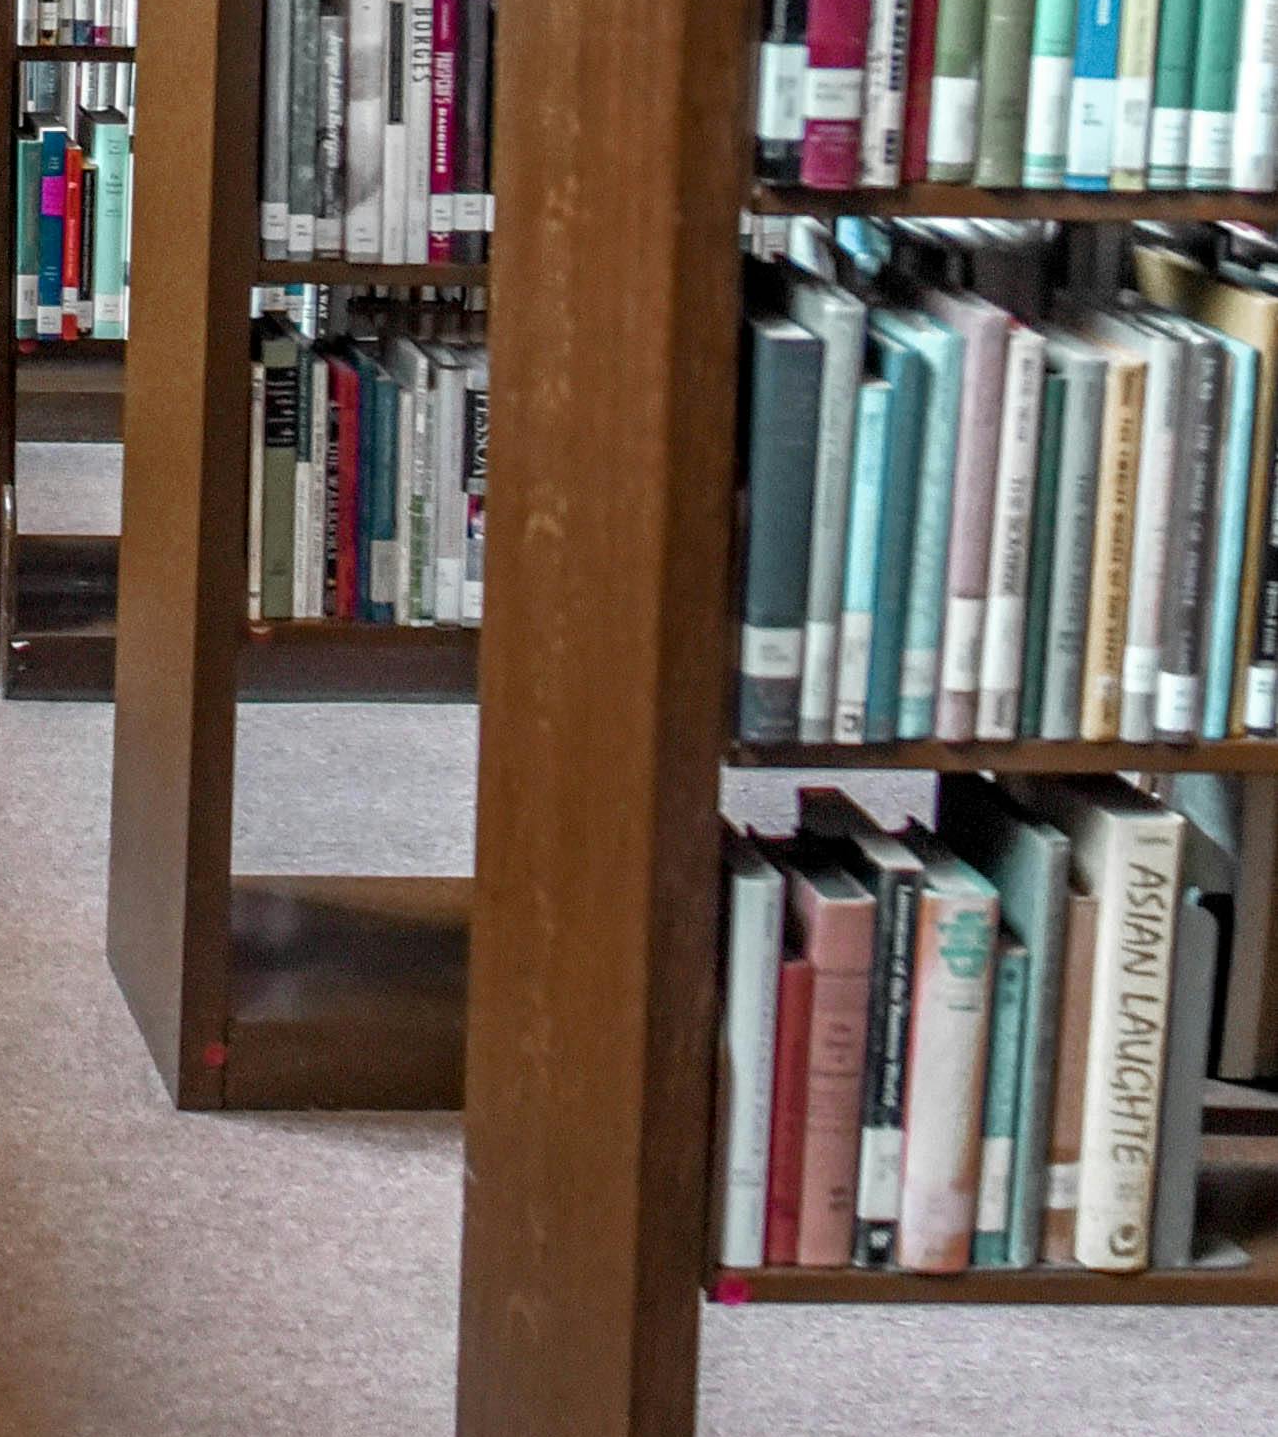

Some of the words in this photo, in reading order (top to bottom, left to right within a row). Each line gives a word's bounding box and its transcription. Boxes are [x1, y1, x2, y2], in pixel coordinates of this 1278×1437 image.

[325, 31, 344, 74] Jorge
[412, 7, 432, 83] BORGES
[327, 77, 344, 111] Luis
[323, 114, 343, 168] Borges
[435, 107, 448, 173] DAUGHTER
[1119, 862, 1171, 976] ASIAN
[1110, 992, 1161, 1168] LAUGHTE
